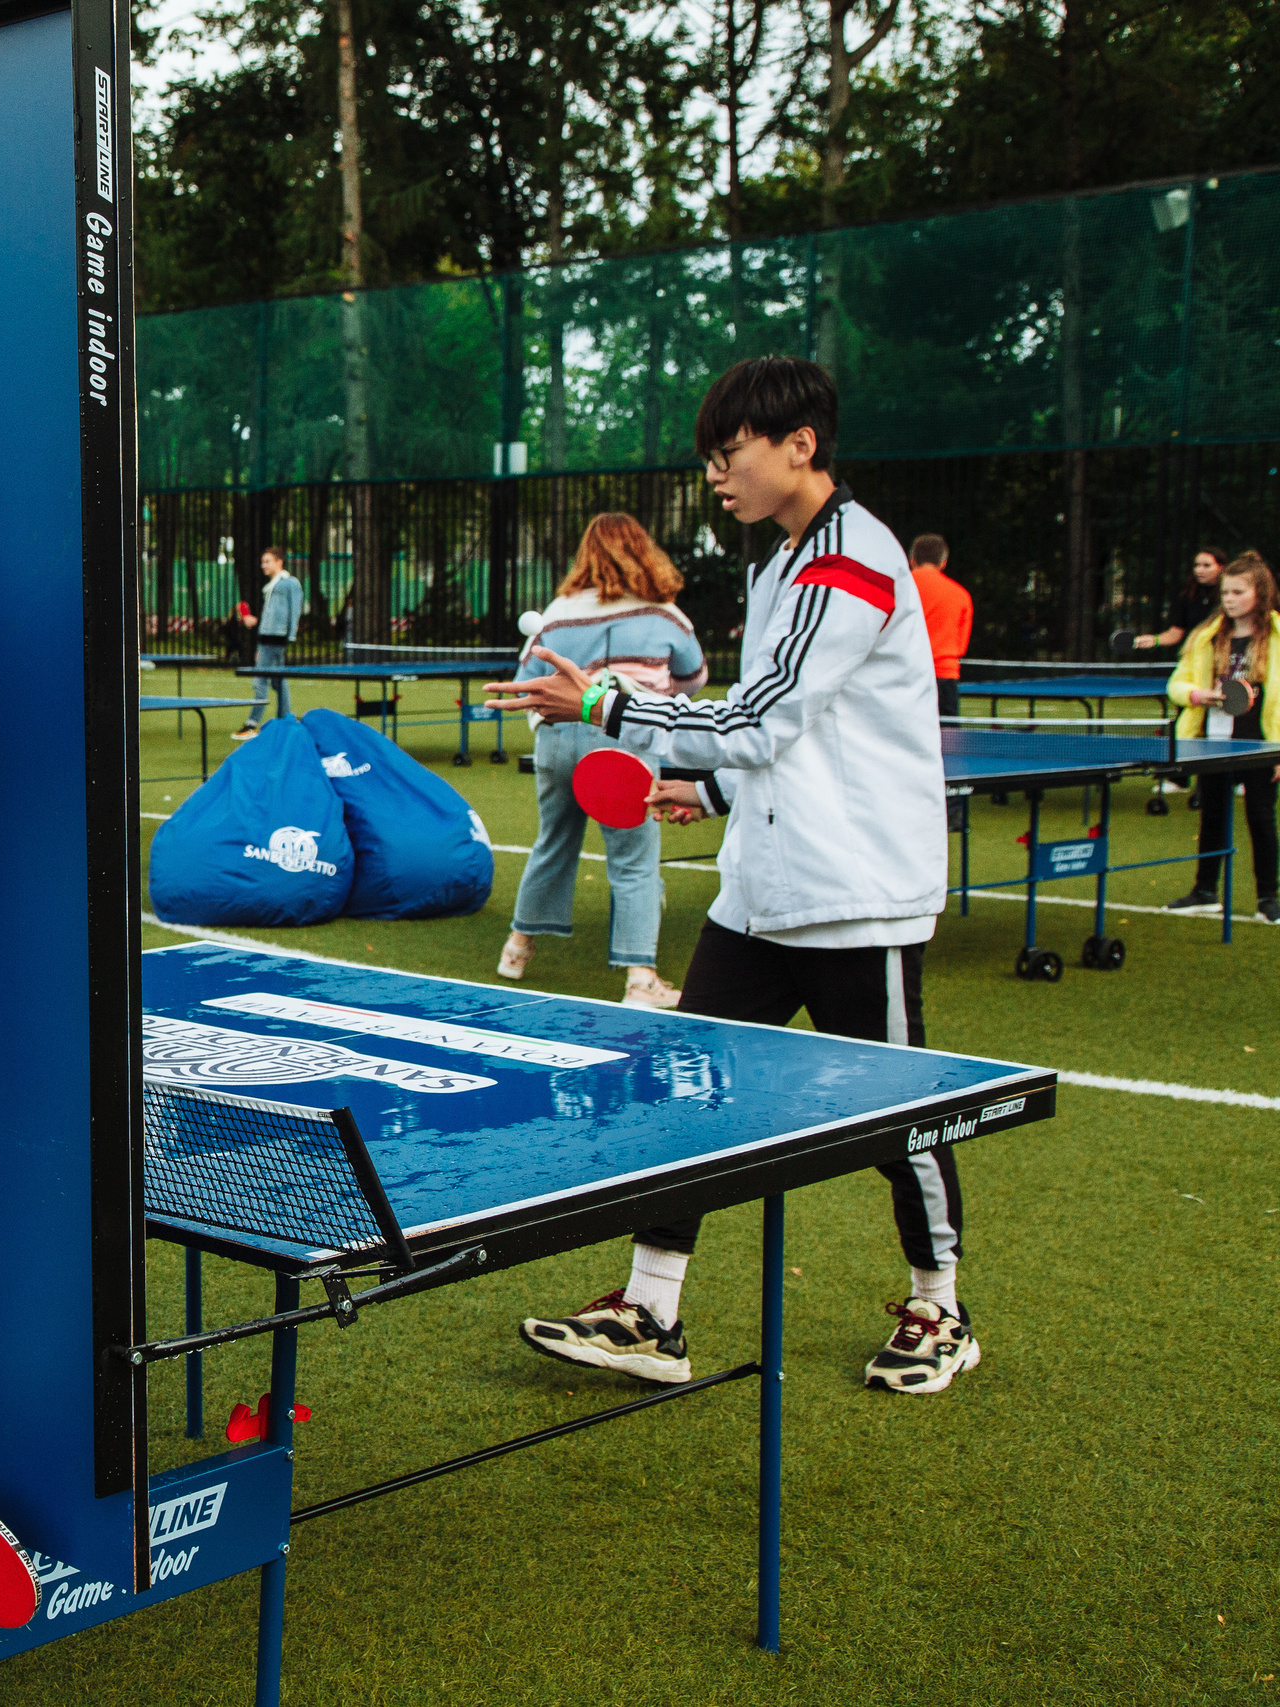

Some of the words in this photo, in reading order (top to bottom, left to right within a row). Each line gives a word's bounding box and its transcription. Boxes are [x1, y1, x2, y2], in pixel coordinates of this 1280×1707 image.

[96, 70, 110, 144] START
[98, 150, 111, 197] LINE
[85, 211, 113, 295] Game
[88, 307, 115, 407] indoor
[908, 1126, 939, 1152] Game
[942, 1114, 978, 1143] indoor
[982, 1104, 1007, 1119] START
[1008, 1100, 1024, 1112] LINE
[153, 1492, 219, 1540] LINE
[20, 1551, 35, 1573] LINE
[46, 1581, 114, 1620] Game
